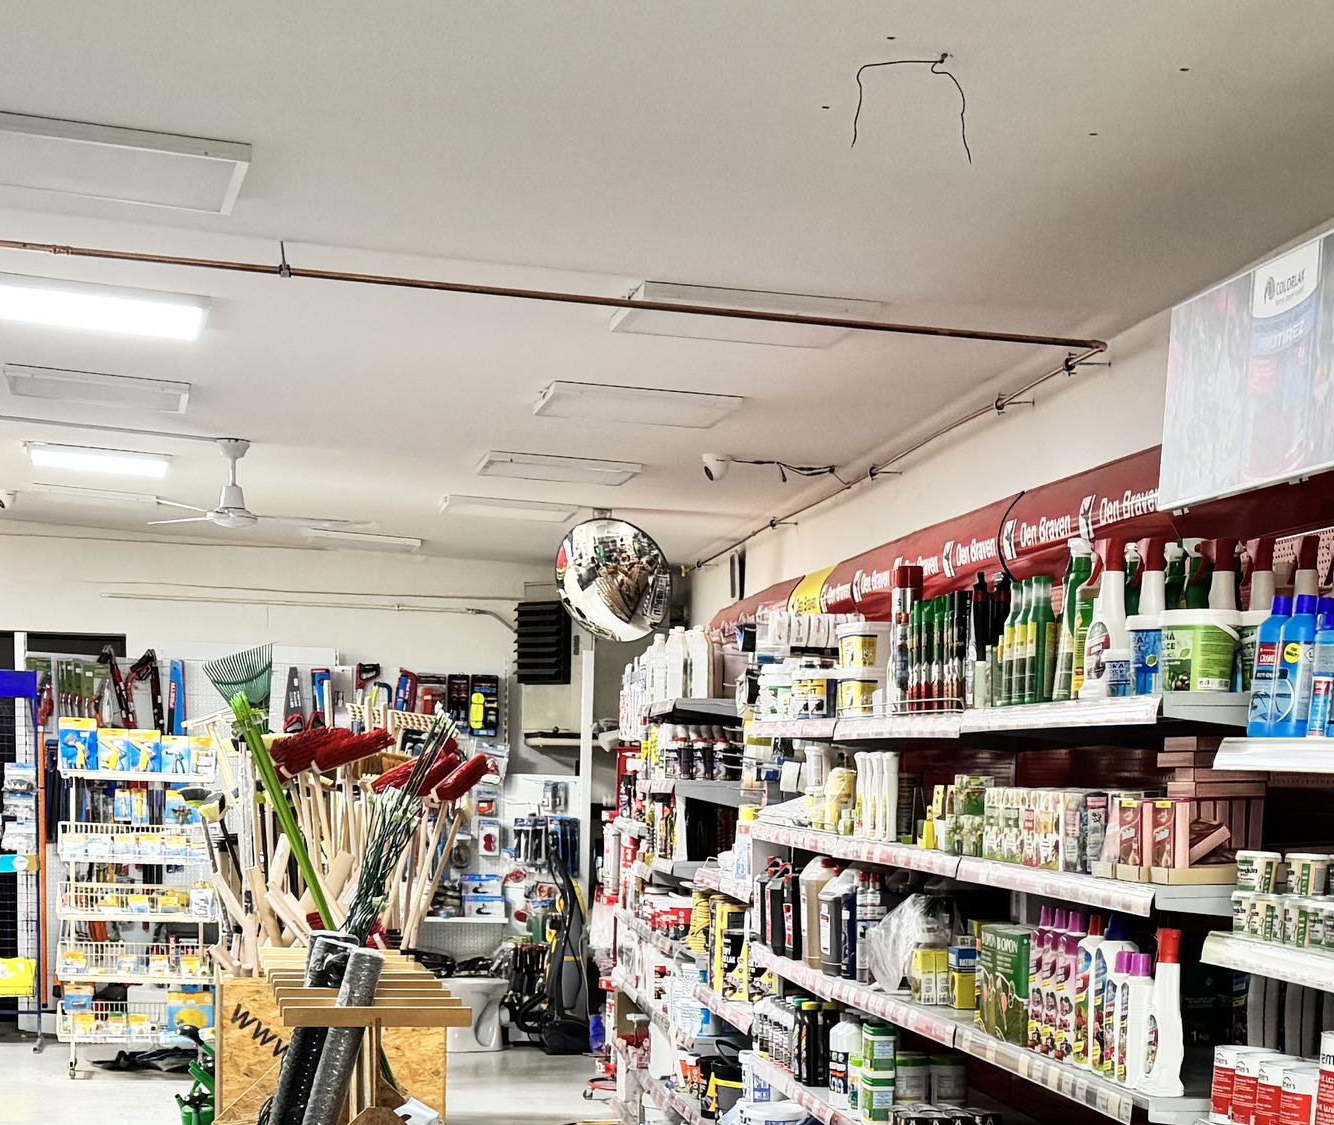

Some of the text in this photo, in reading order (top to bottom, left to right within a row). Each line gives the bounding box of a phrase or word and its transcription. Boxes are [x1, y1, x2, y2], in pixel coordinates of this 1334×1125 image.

[1099, 501, 1119, 526] Den
[1020, 514, 1072, 547] Den Braven
[970, 537, 996, 562] Braven
